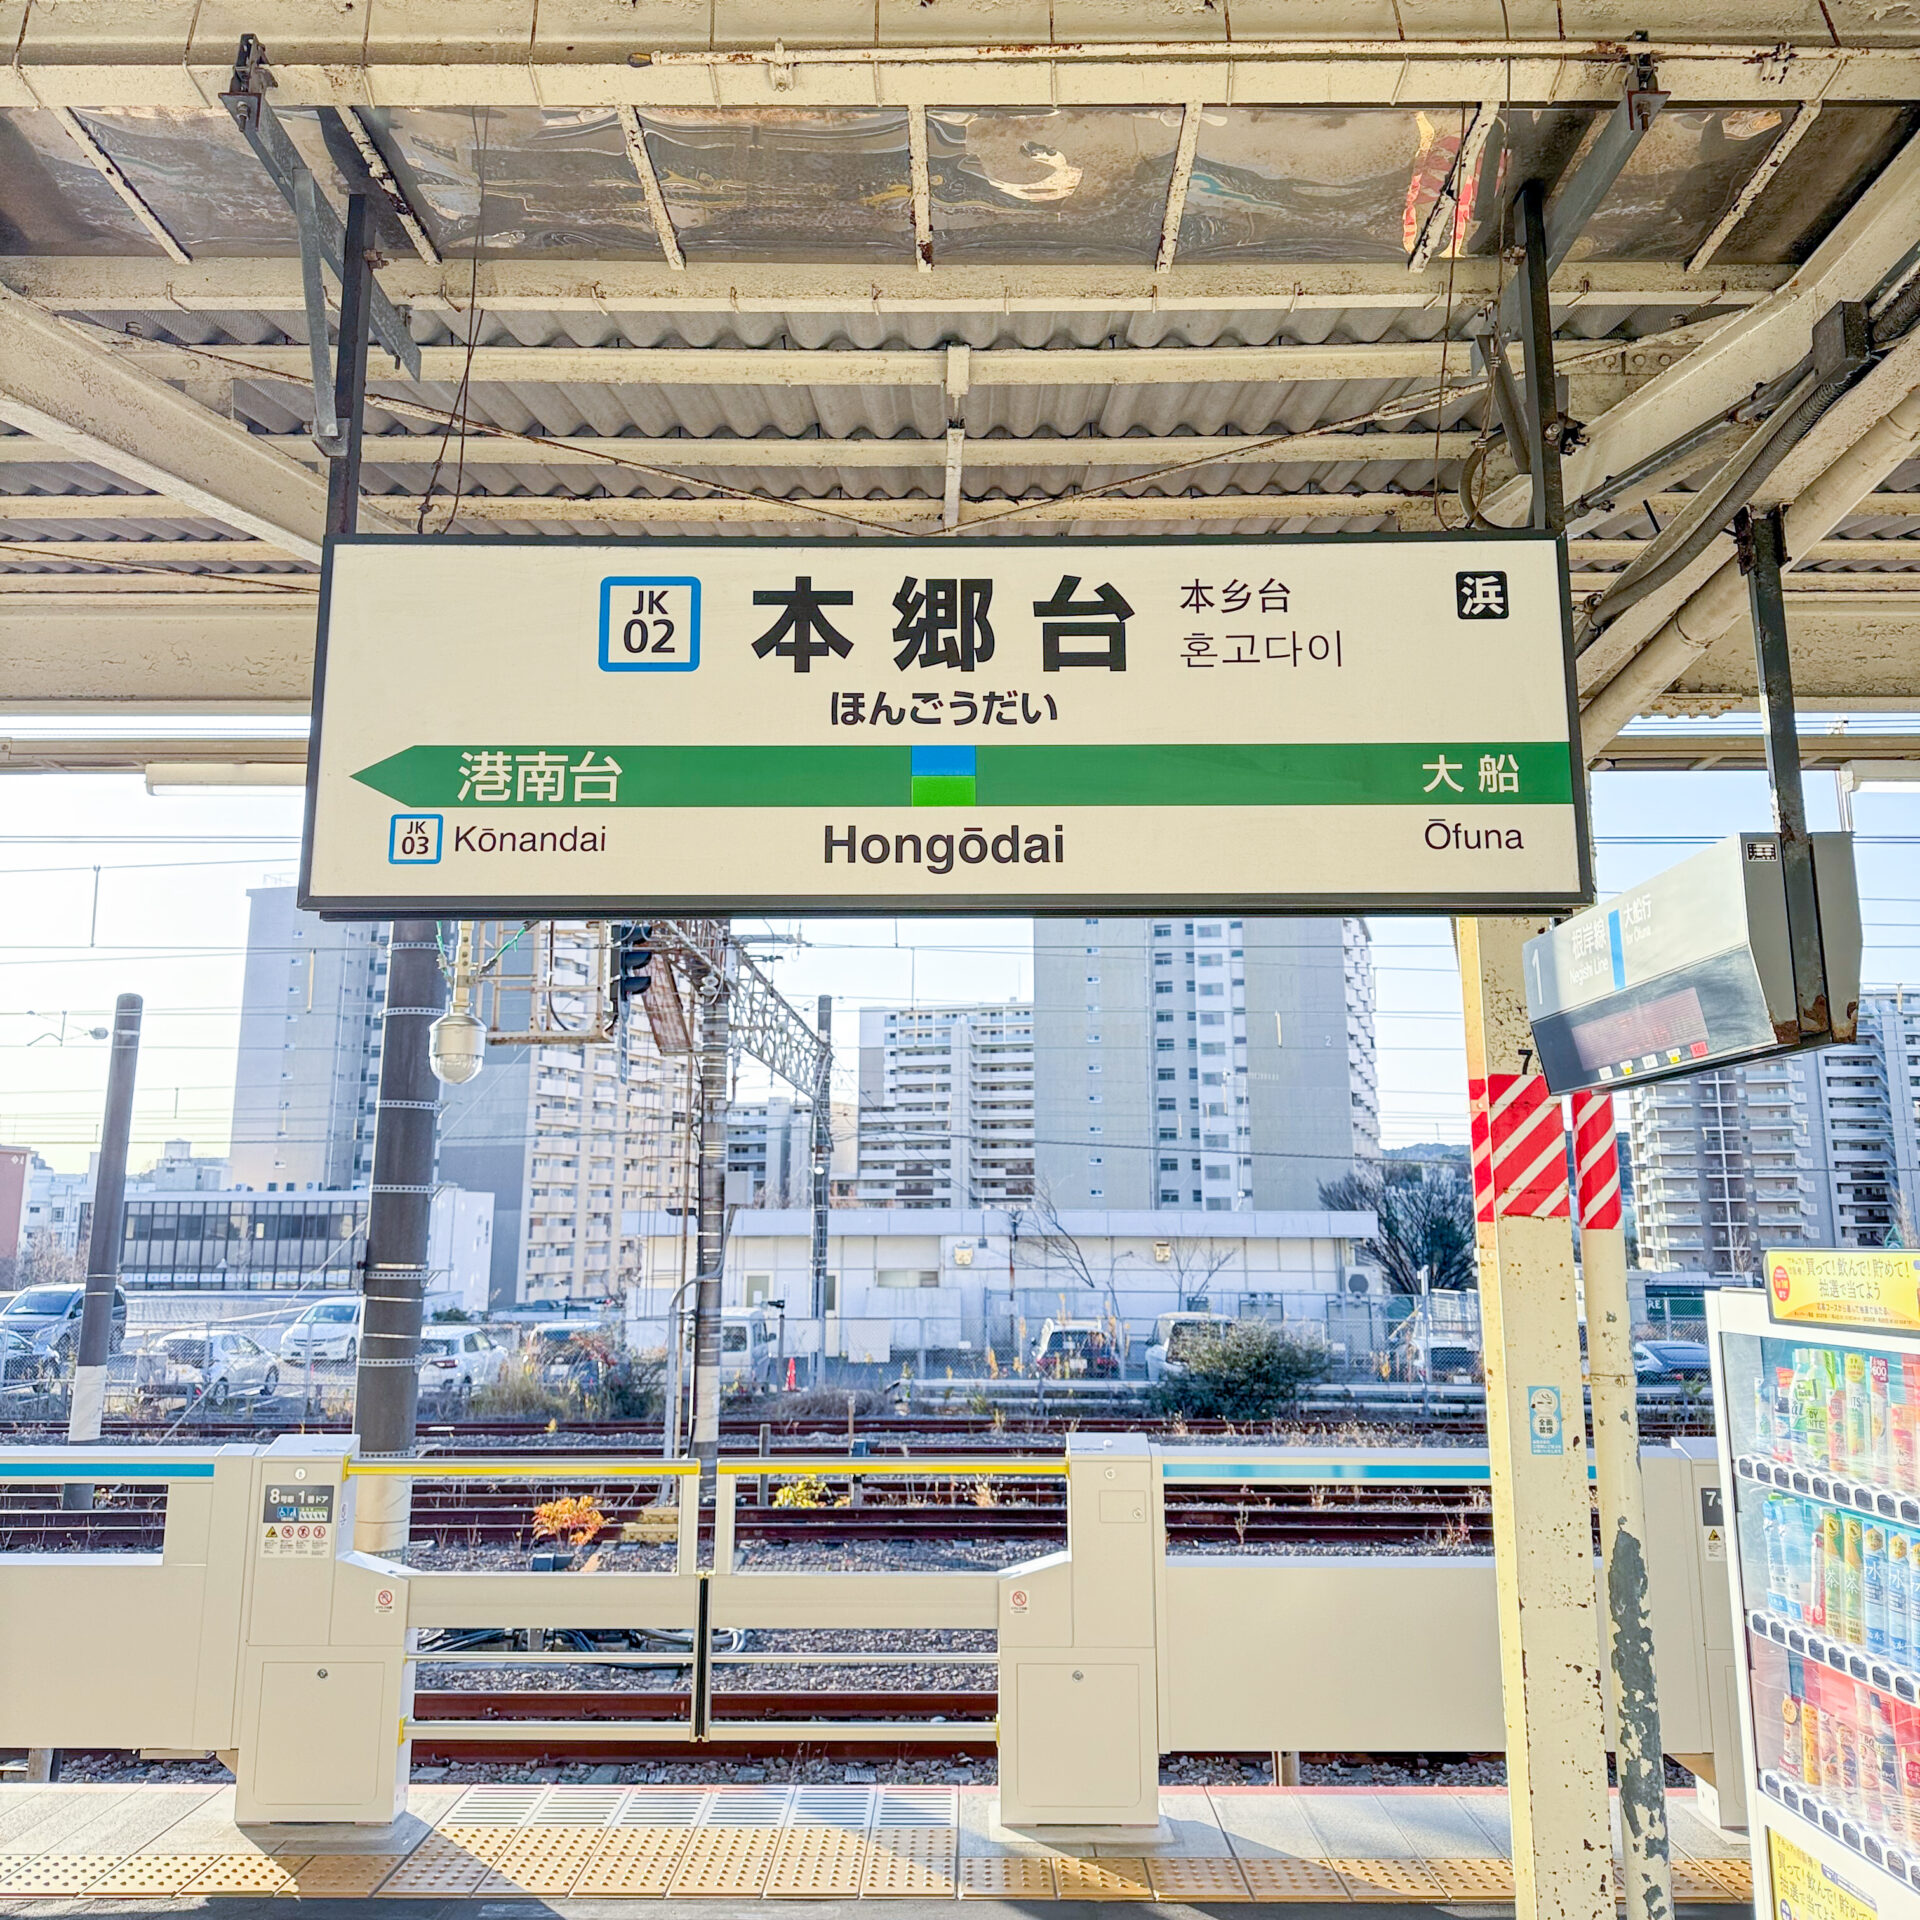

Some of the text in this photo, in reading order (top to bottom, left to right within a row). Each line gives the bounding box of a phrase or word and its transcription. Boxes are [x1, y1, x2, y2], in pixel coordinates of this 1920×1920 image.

[633, 590, 669, 615] JK
[1180, 577, 1291, 614] 本乡台
[1461, 576, 1505, 615] 浜
[623, 618, 676, 654] 02
[751, 574, 1136, 673] 本郷台
[1180, 630, 1342, 668] 혼고다이
[831, 690, 1058, 726] ほんごうだい
[457, 750, 623, 802] 港南台
[1422, 754, 1520, 793] 大船
[401, 836, 429, 855] 03
[406, 820, 426, 834] JK
[454, 825, 606, 853] Kōnandai
[1424, 818, 1525, 850] Ōfuna
[824, 824, 1064, 875] Hongōdai
[1572, 918, 1607, 960] 根岸線
[1531, 948, 1543, 1006] 1
[1518, 1049, 1534, 1075] 7
